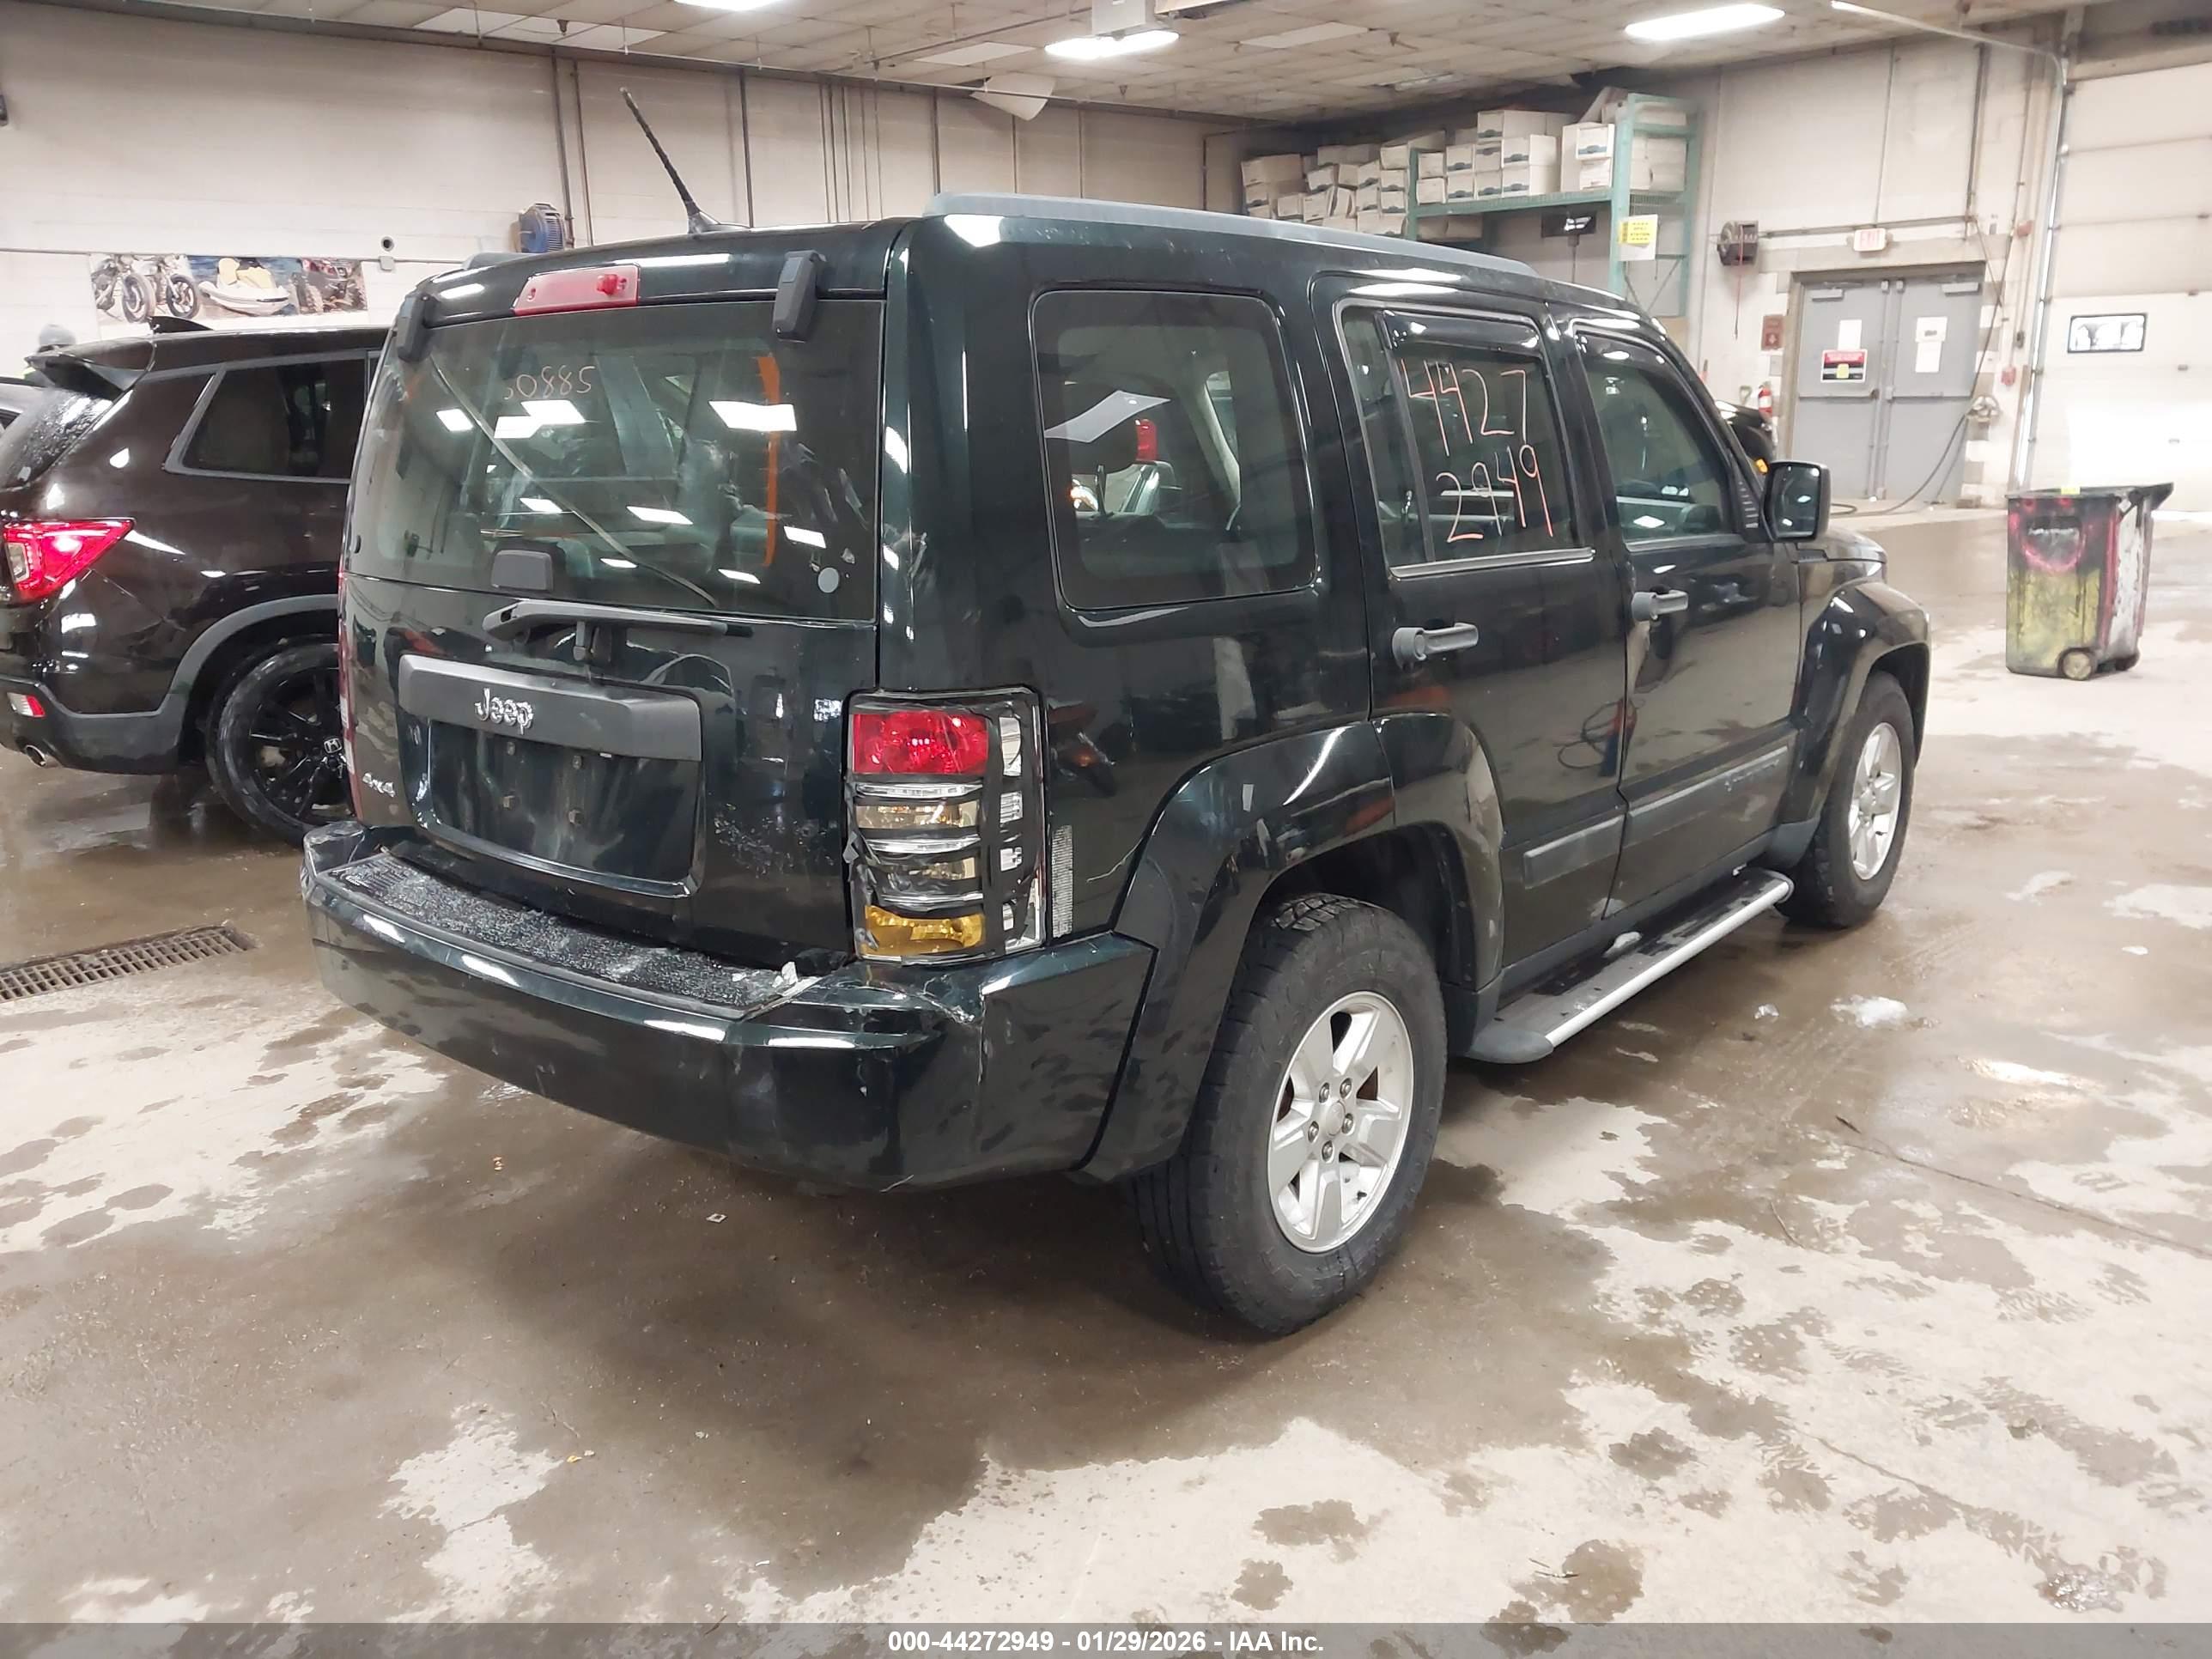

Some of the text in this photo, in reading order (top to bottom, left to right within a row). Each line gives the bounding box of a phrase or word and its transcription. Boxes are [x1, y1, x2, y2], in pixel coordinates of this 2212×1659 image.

[1401, 359, 1526, 457] 4427
[1436, 444, 1553, 543] 2949
[474, 688, 533, 735] Jeep
